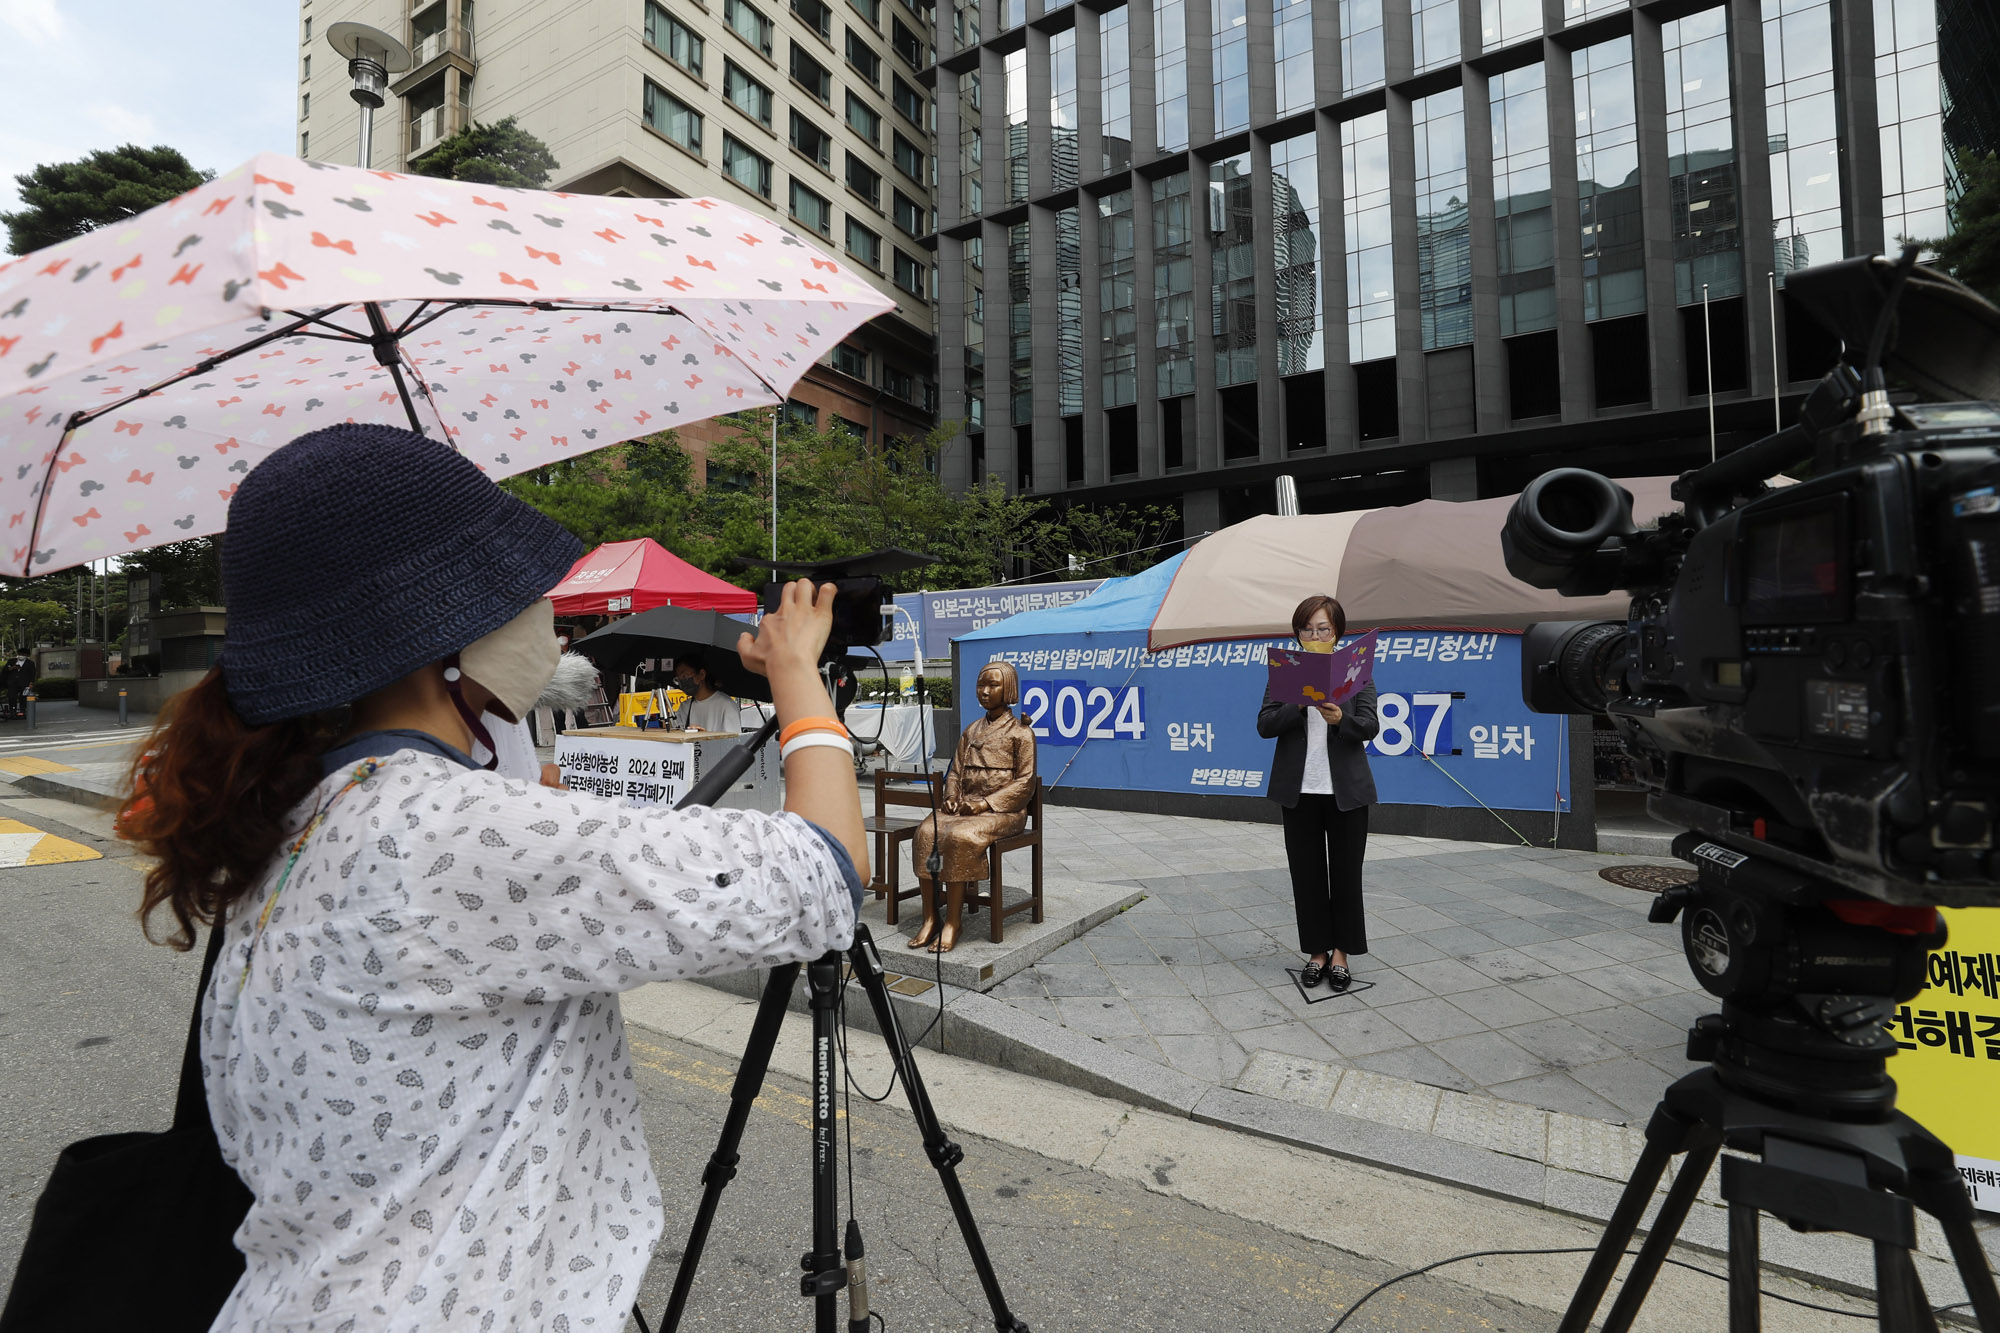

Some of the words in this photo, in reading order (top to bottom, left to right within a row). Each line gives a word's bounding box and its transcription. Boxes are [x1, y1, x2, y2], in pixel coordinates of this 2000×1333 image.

[1023, 686, 1145, 741] 2024
[1363, 692, 1452, 756] 87
[1167, 722, 1214, 752] 일차
[1469, 724, 1536, 760] 일차
[628, 758, 656, 776] 2024
[661, 760, 685, 780] 일째
[1190, 768, 1264, 788] 반일행동
[626, 781, 674, 805] 즉각폐기!
[1921, 951, 2000, 999] 예제
[818, 1037, 830, 1120] Manfrotto
